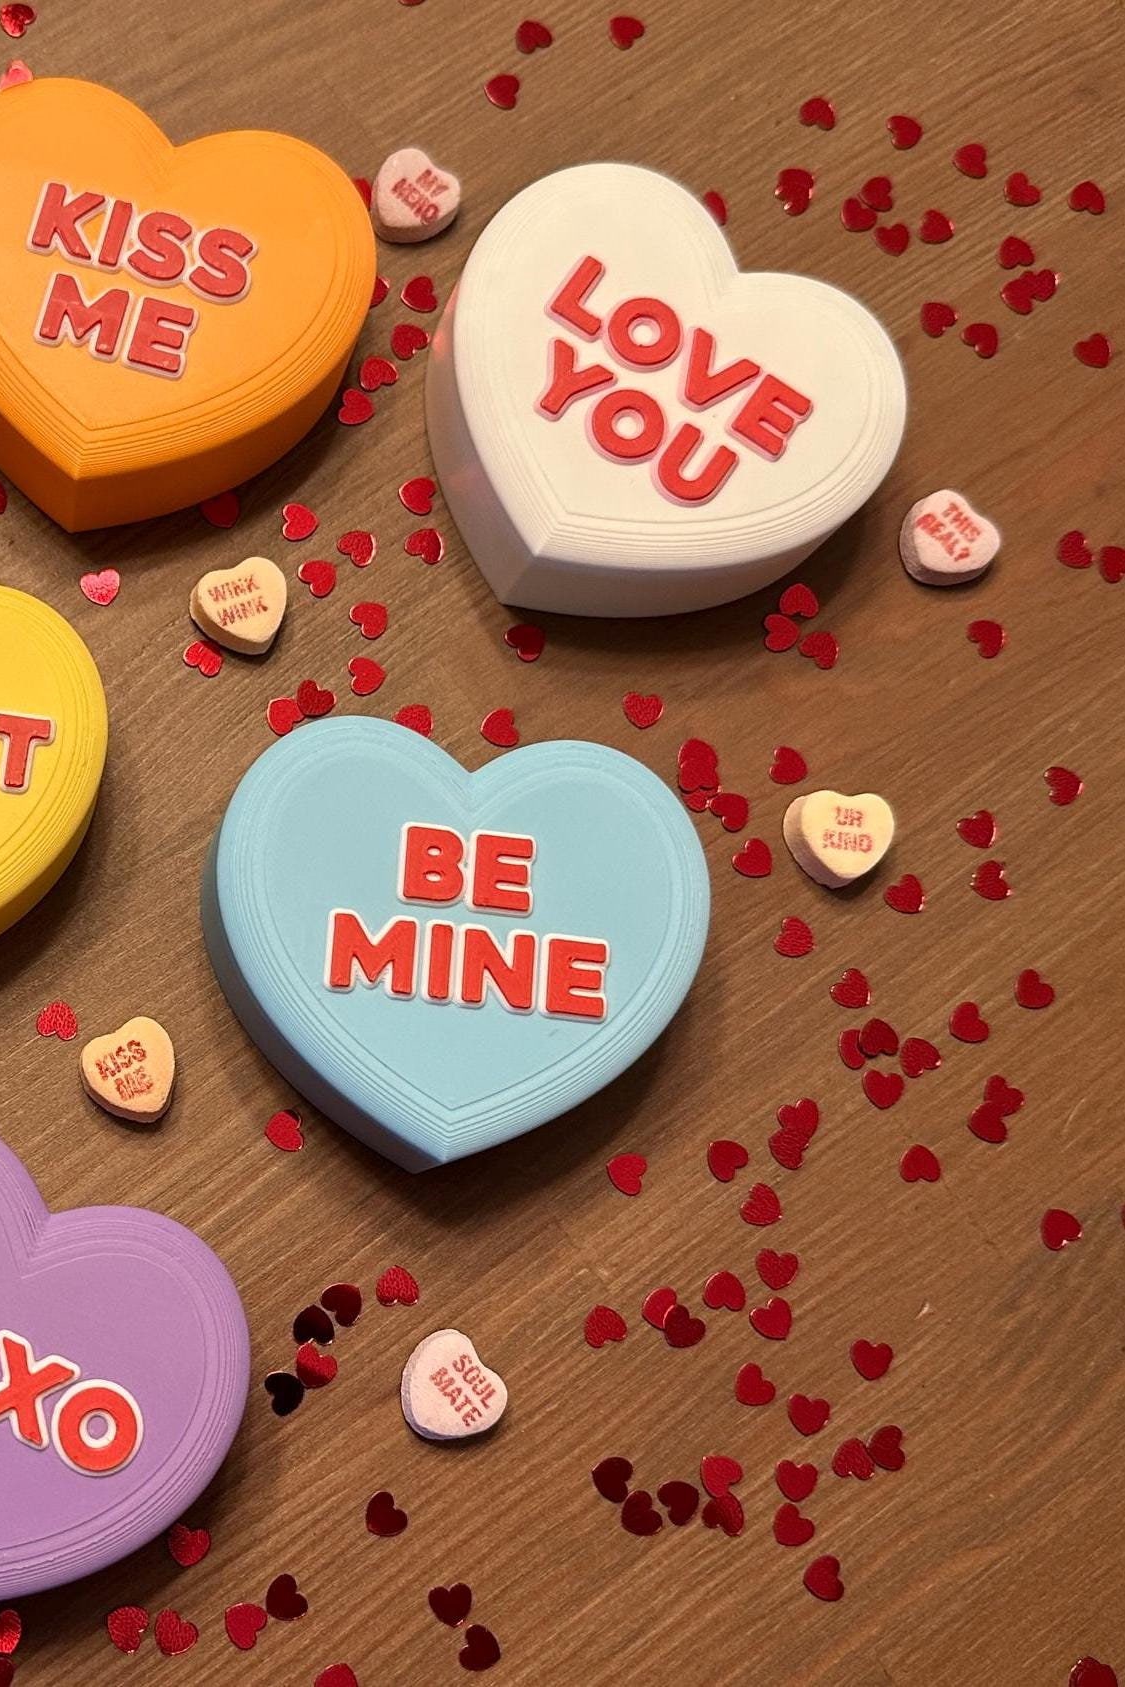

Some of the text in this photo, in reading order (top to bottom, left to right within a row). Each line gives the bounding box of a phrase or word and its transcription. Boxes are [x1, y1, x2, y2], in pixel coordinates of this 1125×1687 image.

[416, 168, 450, 198] MY
[29, 182, 255, 299] KISS
[37, 272, 196, 375] ME
[548, 254, 813, 458] LOVE
[537, 338, 739, 503] YOU
[915, 513, 972, 562] REAL?
[942, 502, 982, 543] THIS
[208, 575, 261, 602] WINK
[400, 824, 536, 914] BE
[327, 910, 609, 1020] MINE
[95, 1039, 147, 1081] KISS
[429, 1366, 482, 1427] MATE
[452, 1354, 496, 1410] SOUL
